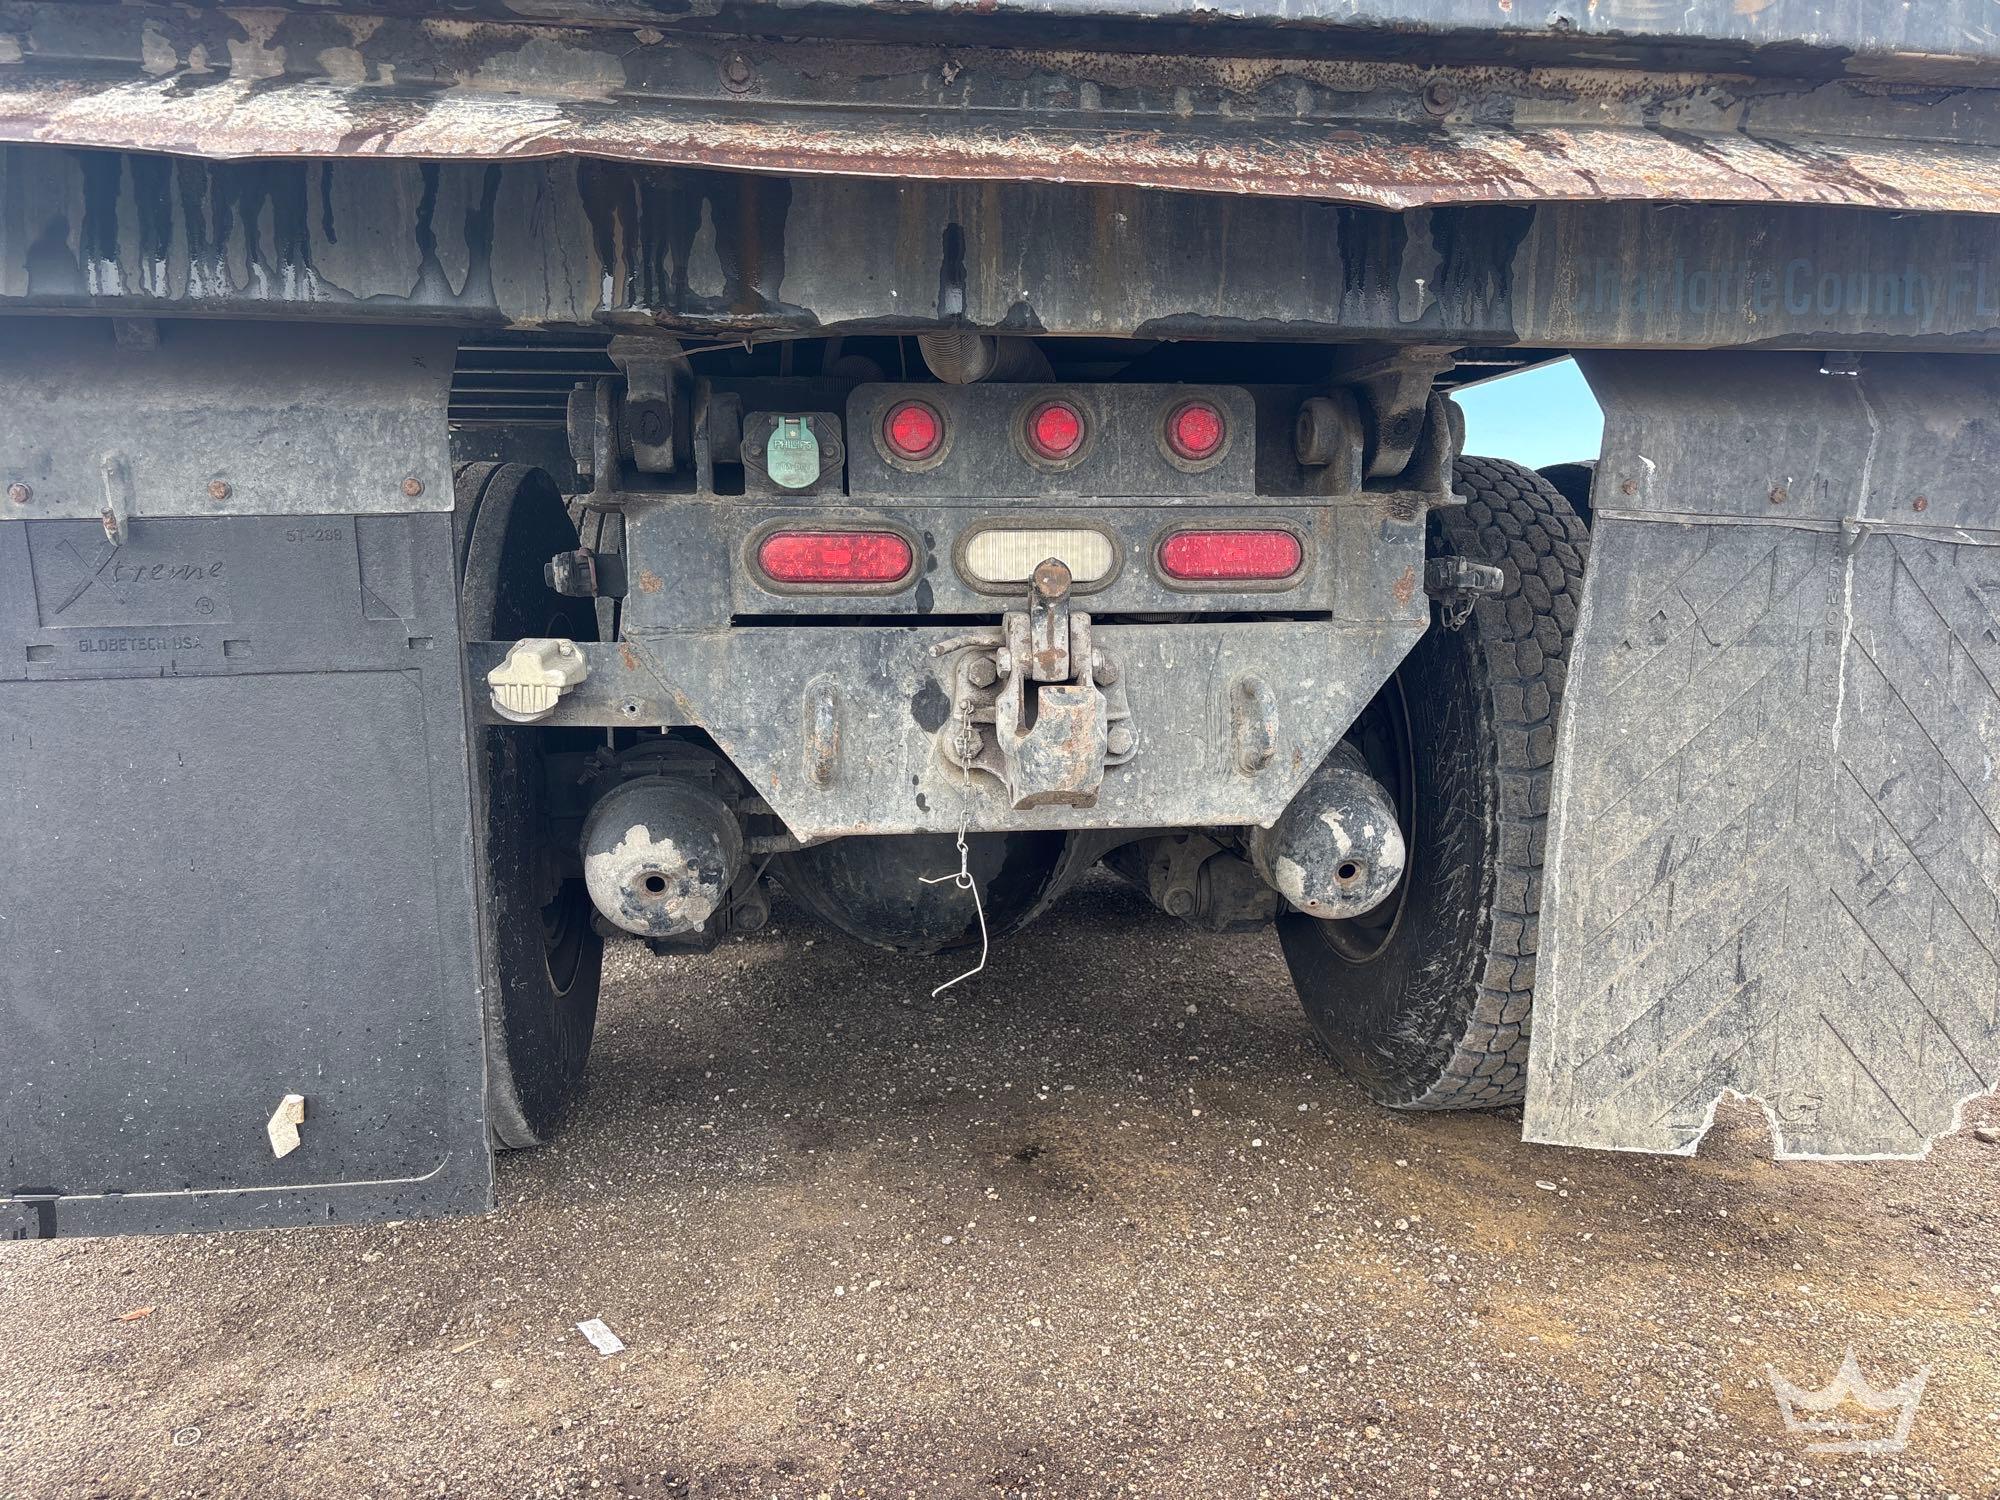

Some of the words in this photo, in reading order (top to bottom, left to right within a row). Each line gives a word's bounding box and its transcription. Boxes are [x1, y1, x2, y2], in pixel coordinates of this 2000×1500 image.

[54, 538, 224, 615] Xtreme
[79, 637, 167, 652] GLOBETECH
[173, 635, 204, 650] USA
